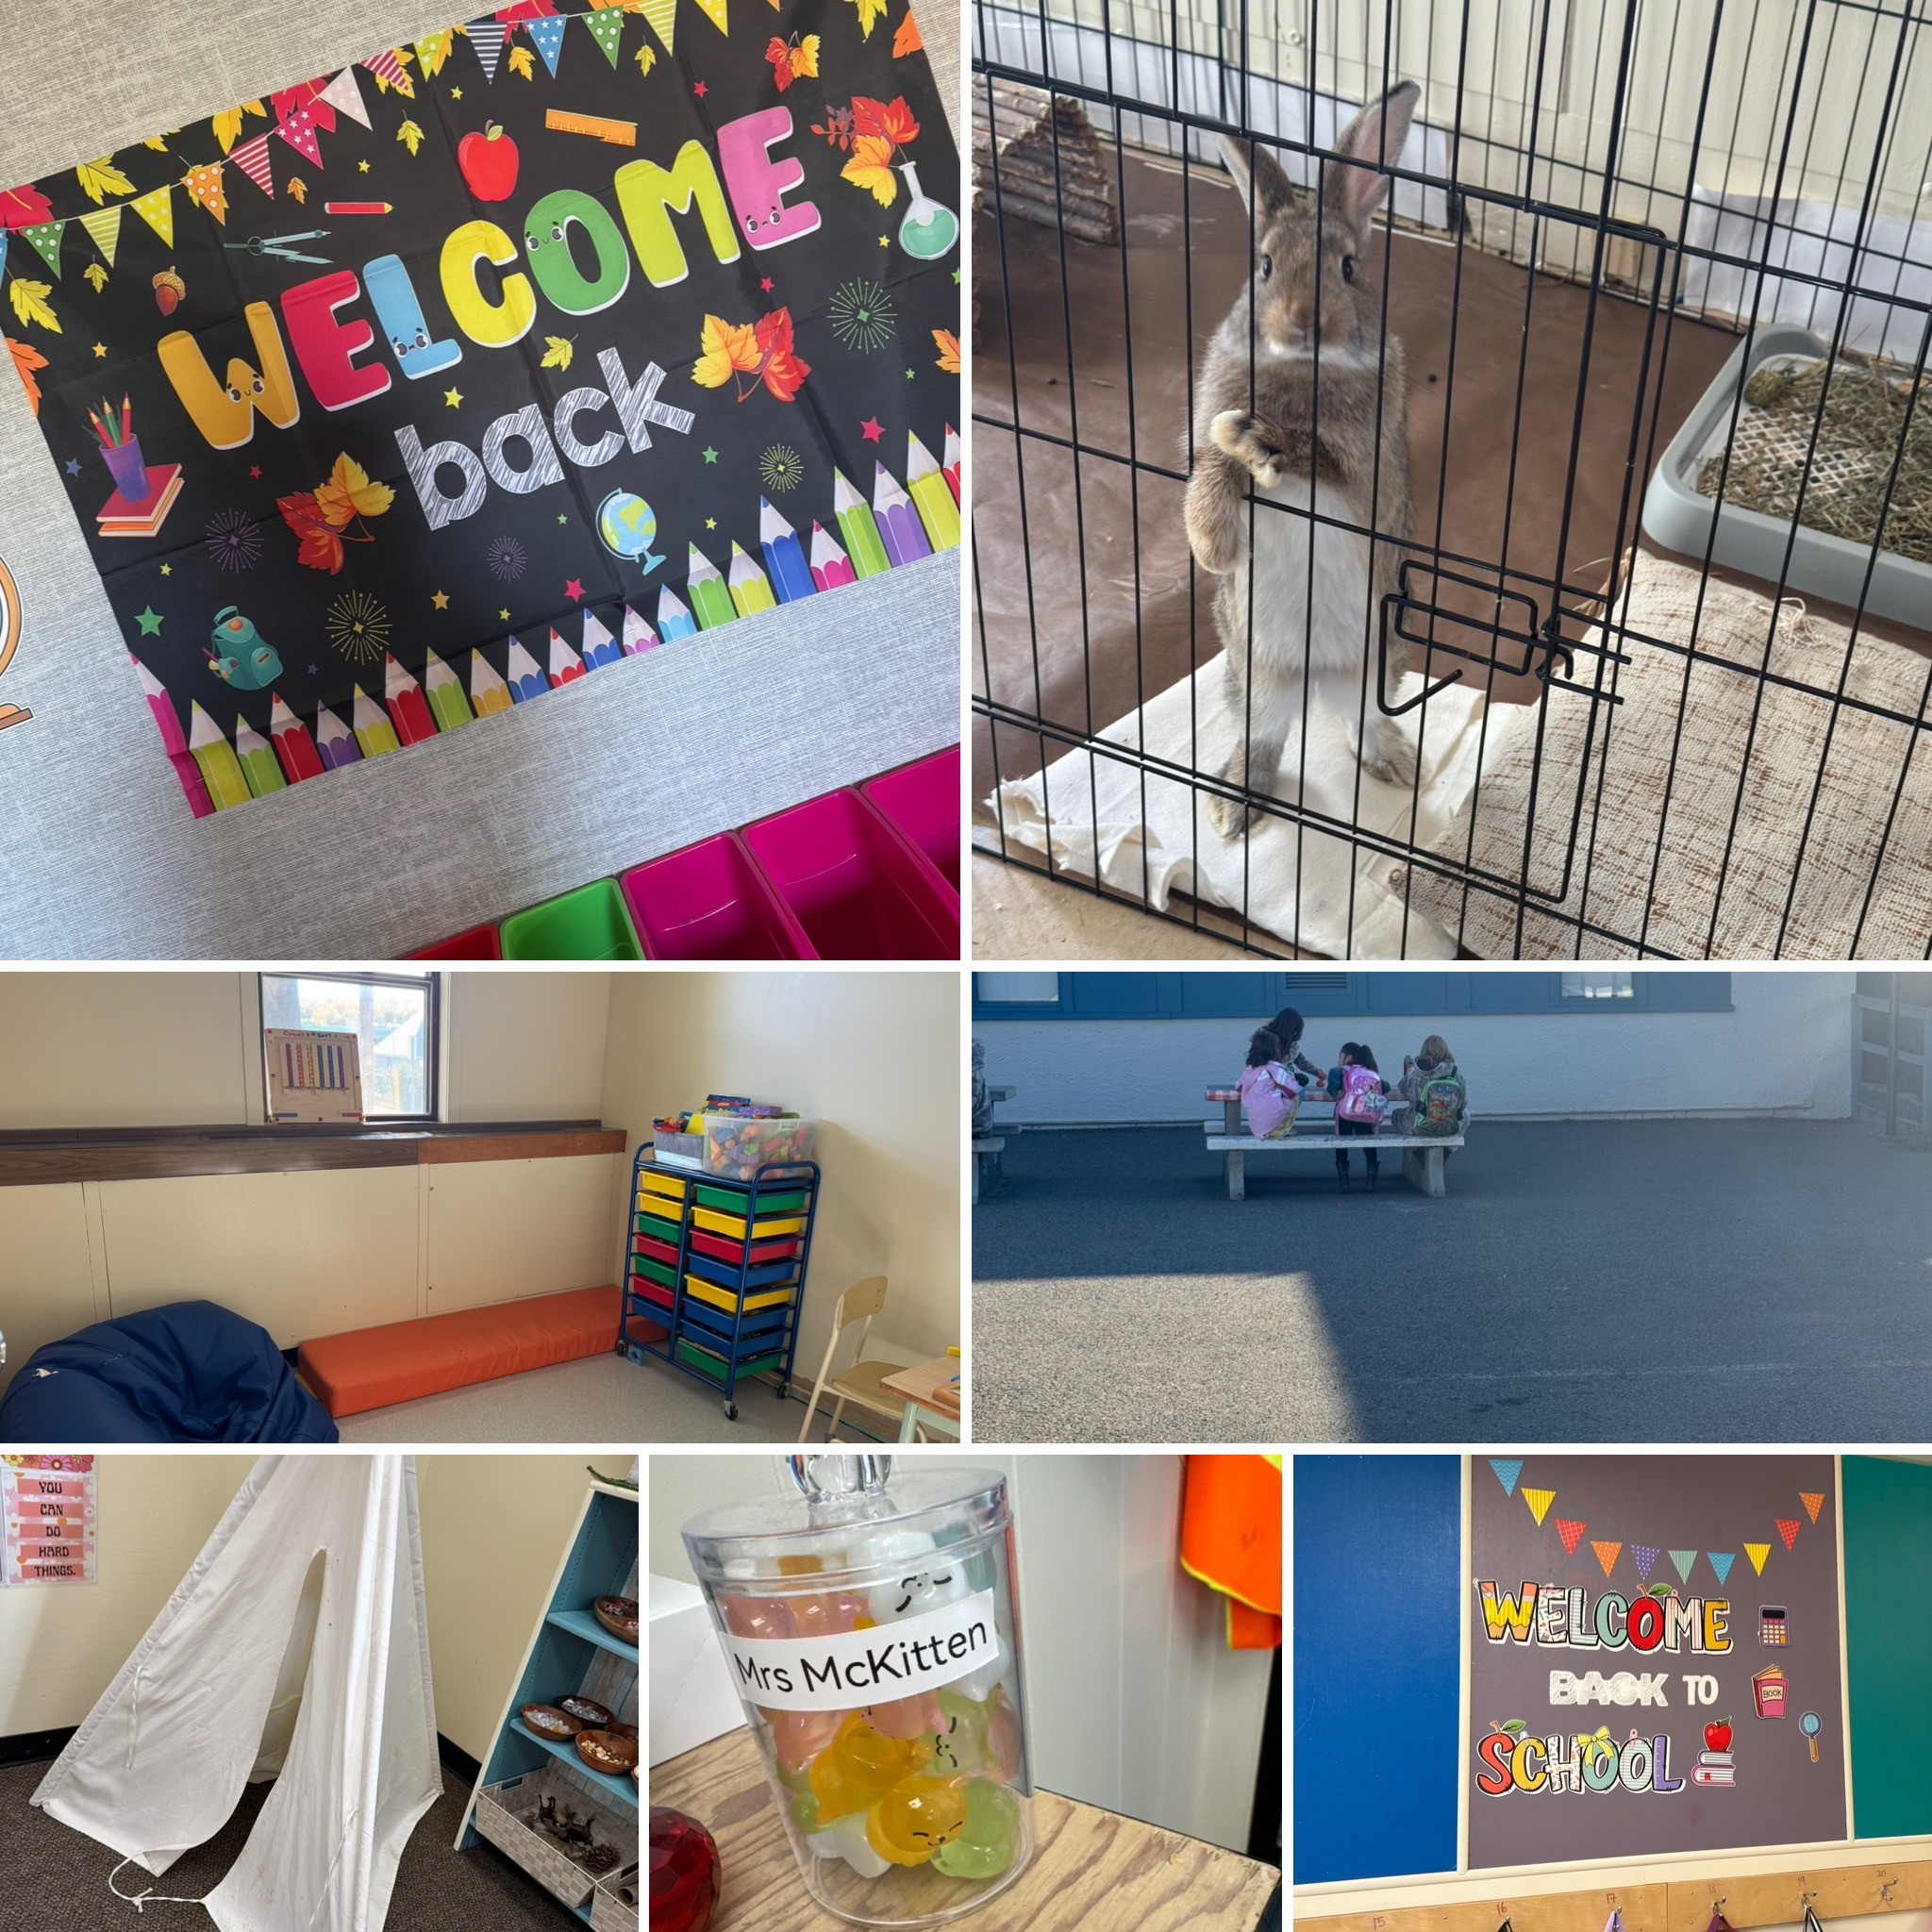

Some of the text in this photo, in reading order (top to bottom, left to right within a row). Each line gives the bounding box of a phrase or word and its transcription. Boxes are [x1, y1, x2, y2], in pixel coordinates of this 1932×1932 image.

[158, 106, 823, 451] WELCOME
[393, 346, 695, 531] back
[39, 1481, 63, 1493] YOU
[40, 1504, 64, 1516] CAN
[45, 1526, 61, 1538] DO
[39, 1546, 70, 1558] HARD
[34, 1565, 76, 1576] THINGS.
[1477, 1579, 1734, 1654] WELCOME
[733, 1621, 988, 1693] Mrs McKitten
[1548, 1670, 1719, 1707] BACK TO
[1762, 1689, 1783, 1699] BOOK
[1476, 1731, 1685, 1795] SCHOOL
[1875, 1870, 1887, 1879] 20
[1797, 1875, 1806, 1887] 19
[1707, 1884, 1717, 1895] 18
[1606, 1892, 1617, 1905] 17
[1496, 1902, 1507, 1916] 16
[1372, 1916, 1386, 1930] 15
